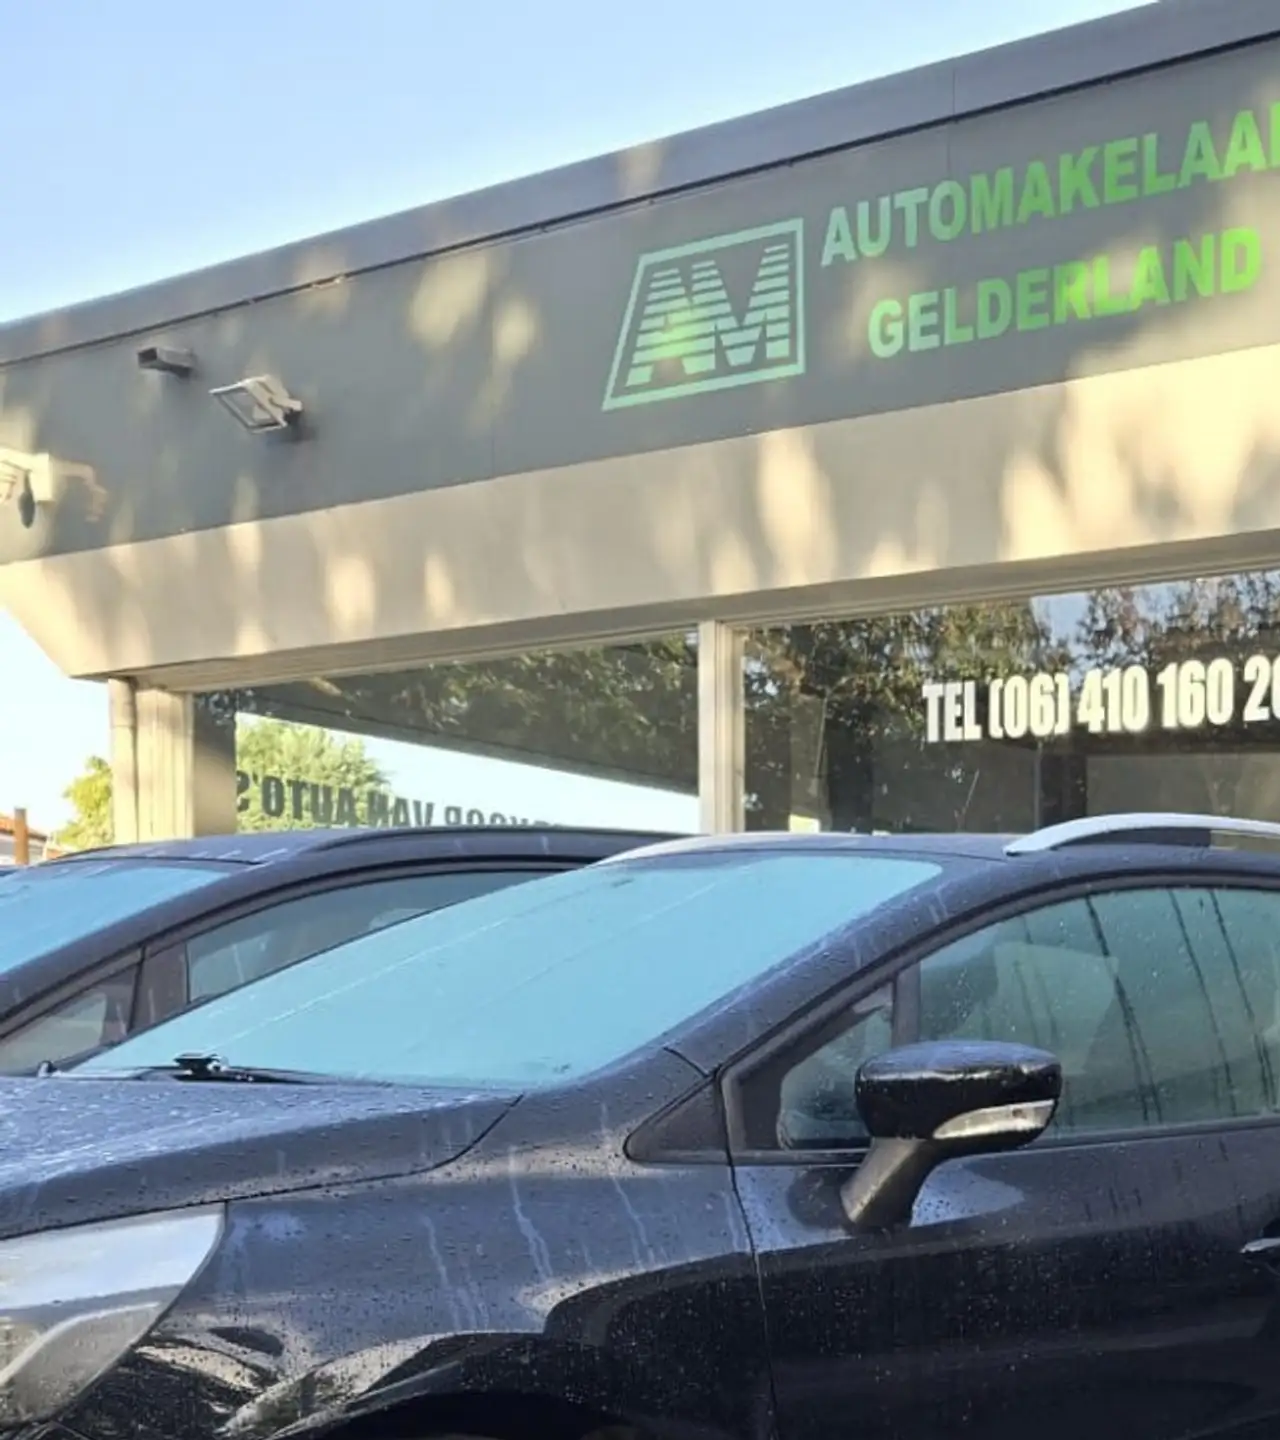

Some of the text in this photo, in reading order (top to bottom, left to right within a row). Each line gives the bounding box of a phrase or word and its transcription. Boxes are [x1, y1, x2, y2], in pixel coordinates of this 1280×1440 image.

[868, 226, 1261, 358] GELDERLAND
[922, 679, 982, 742] TEL
[990, 672, 1070, 739] (06)
[1077, 664, 1149, 733] 410
[1156, 658, 1234, 730] 160
